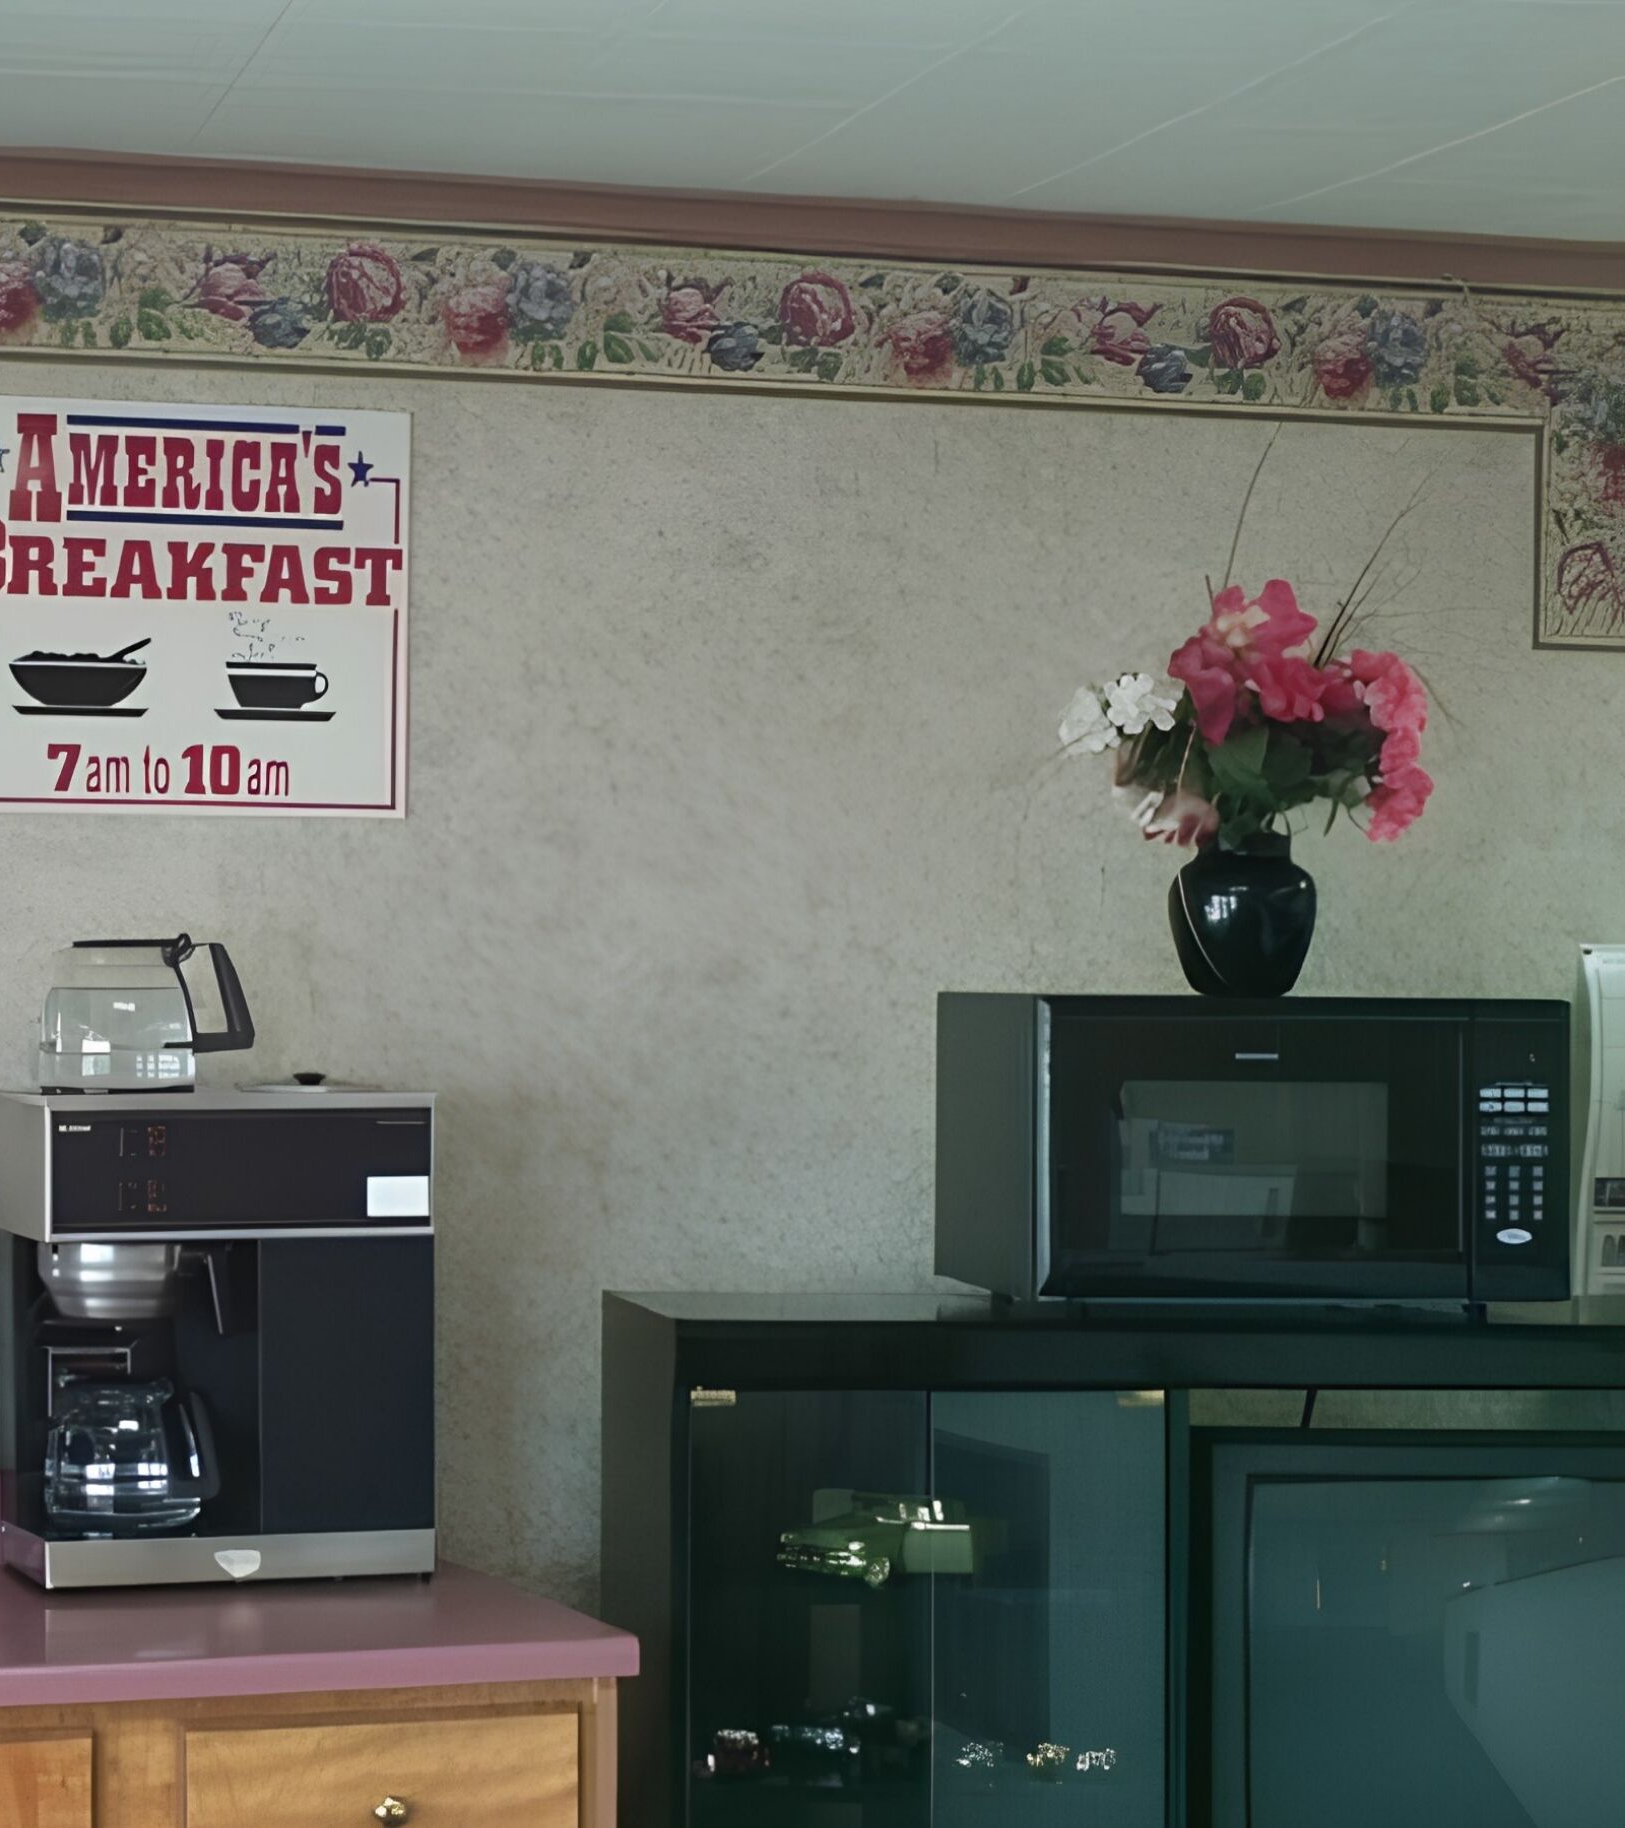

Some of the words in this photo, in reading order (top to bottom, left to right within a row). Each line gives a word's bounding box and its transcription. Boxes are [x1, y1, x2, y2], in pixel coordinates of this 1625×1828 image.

[9, 413, 342, 522] AMERICA'S
[47, 743, 131, 795] 7am
[143, 745, 171, 796] to
